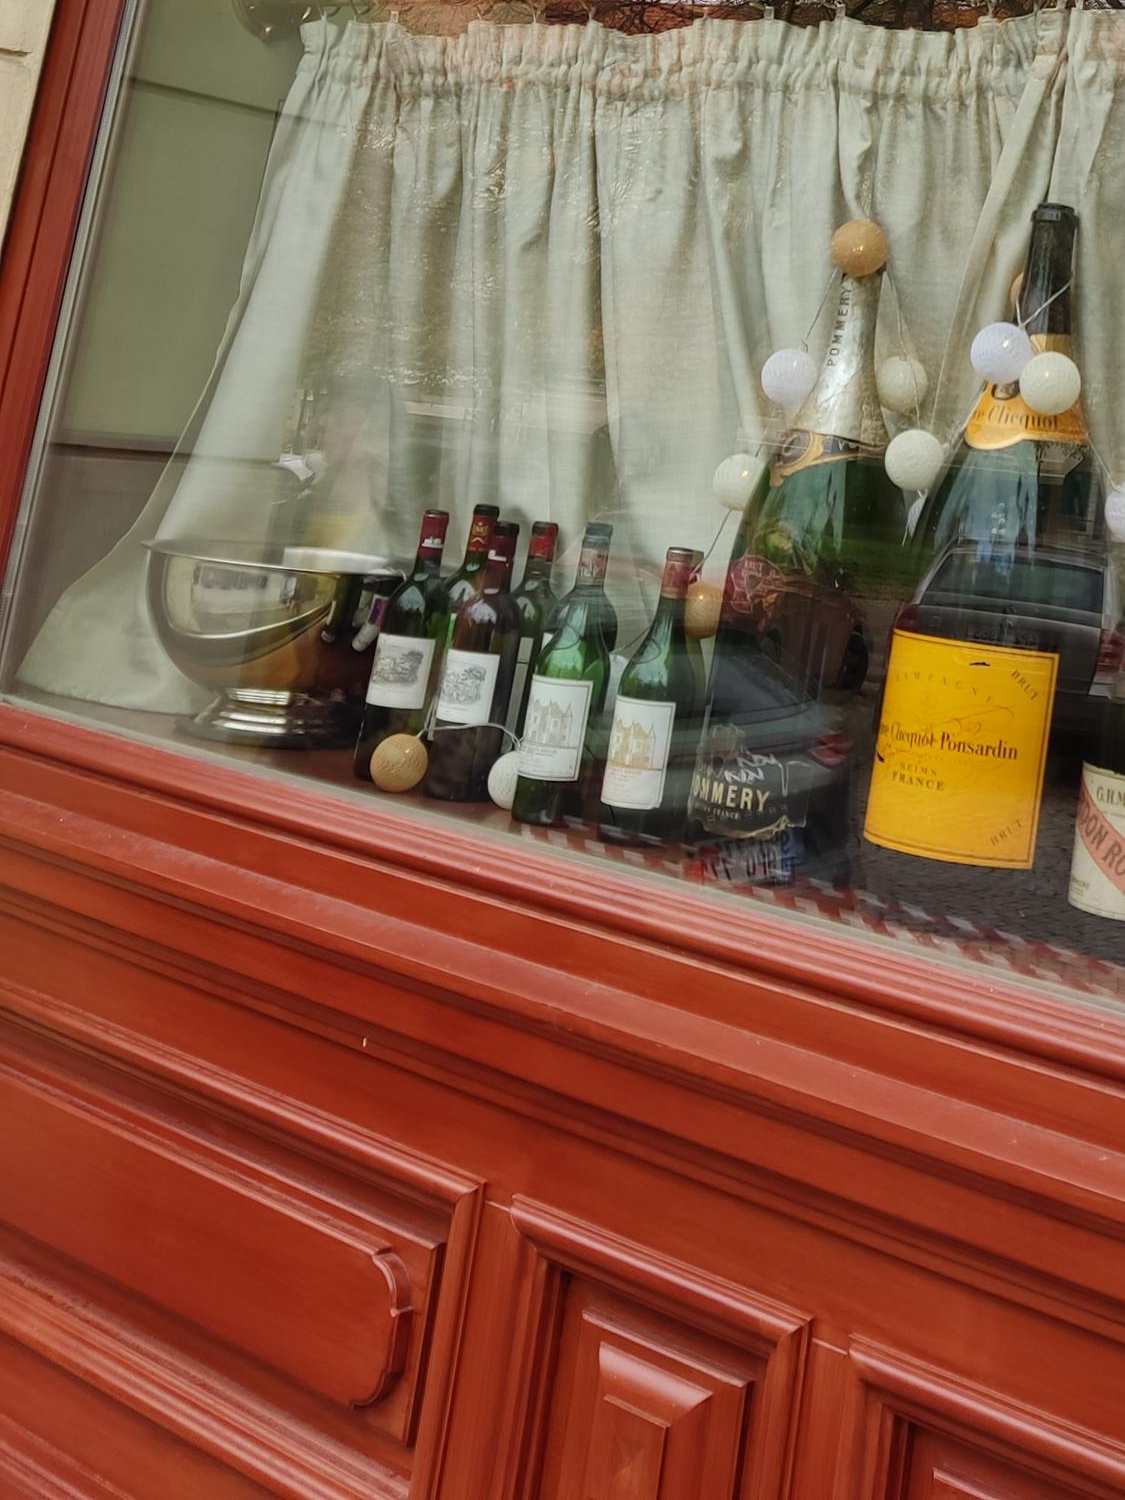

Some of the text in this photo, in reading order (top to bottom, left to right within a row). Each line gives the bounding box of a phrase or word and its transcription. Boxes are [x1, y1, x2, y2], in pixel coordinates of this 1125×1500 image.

[826, 285, 853, 367] POMMERY
[1010, 669, 1040, 701] BRUT
[939, 731, 1019, 760] Ponsardin
[891, 771, 945, 791] FRANCE
[899, 762, 938, 776] REIMS
[692, 774, 771, 813] OMMERY
[989, 818, 1026, 847] BRUT
